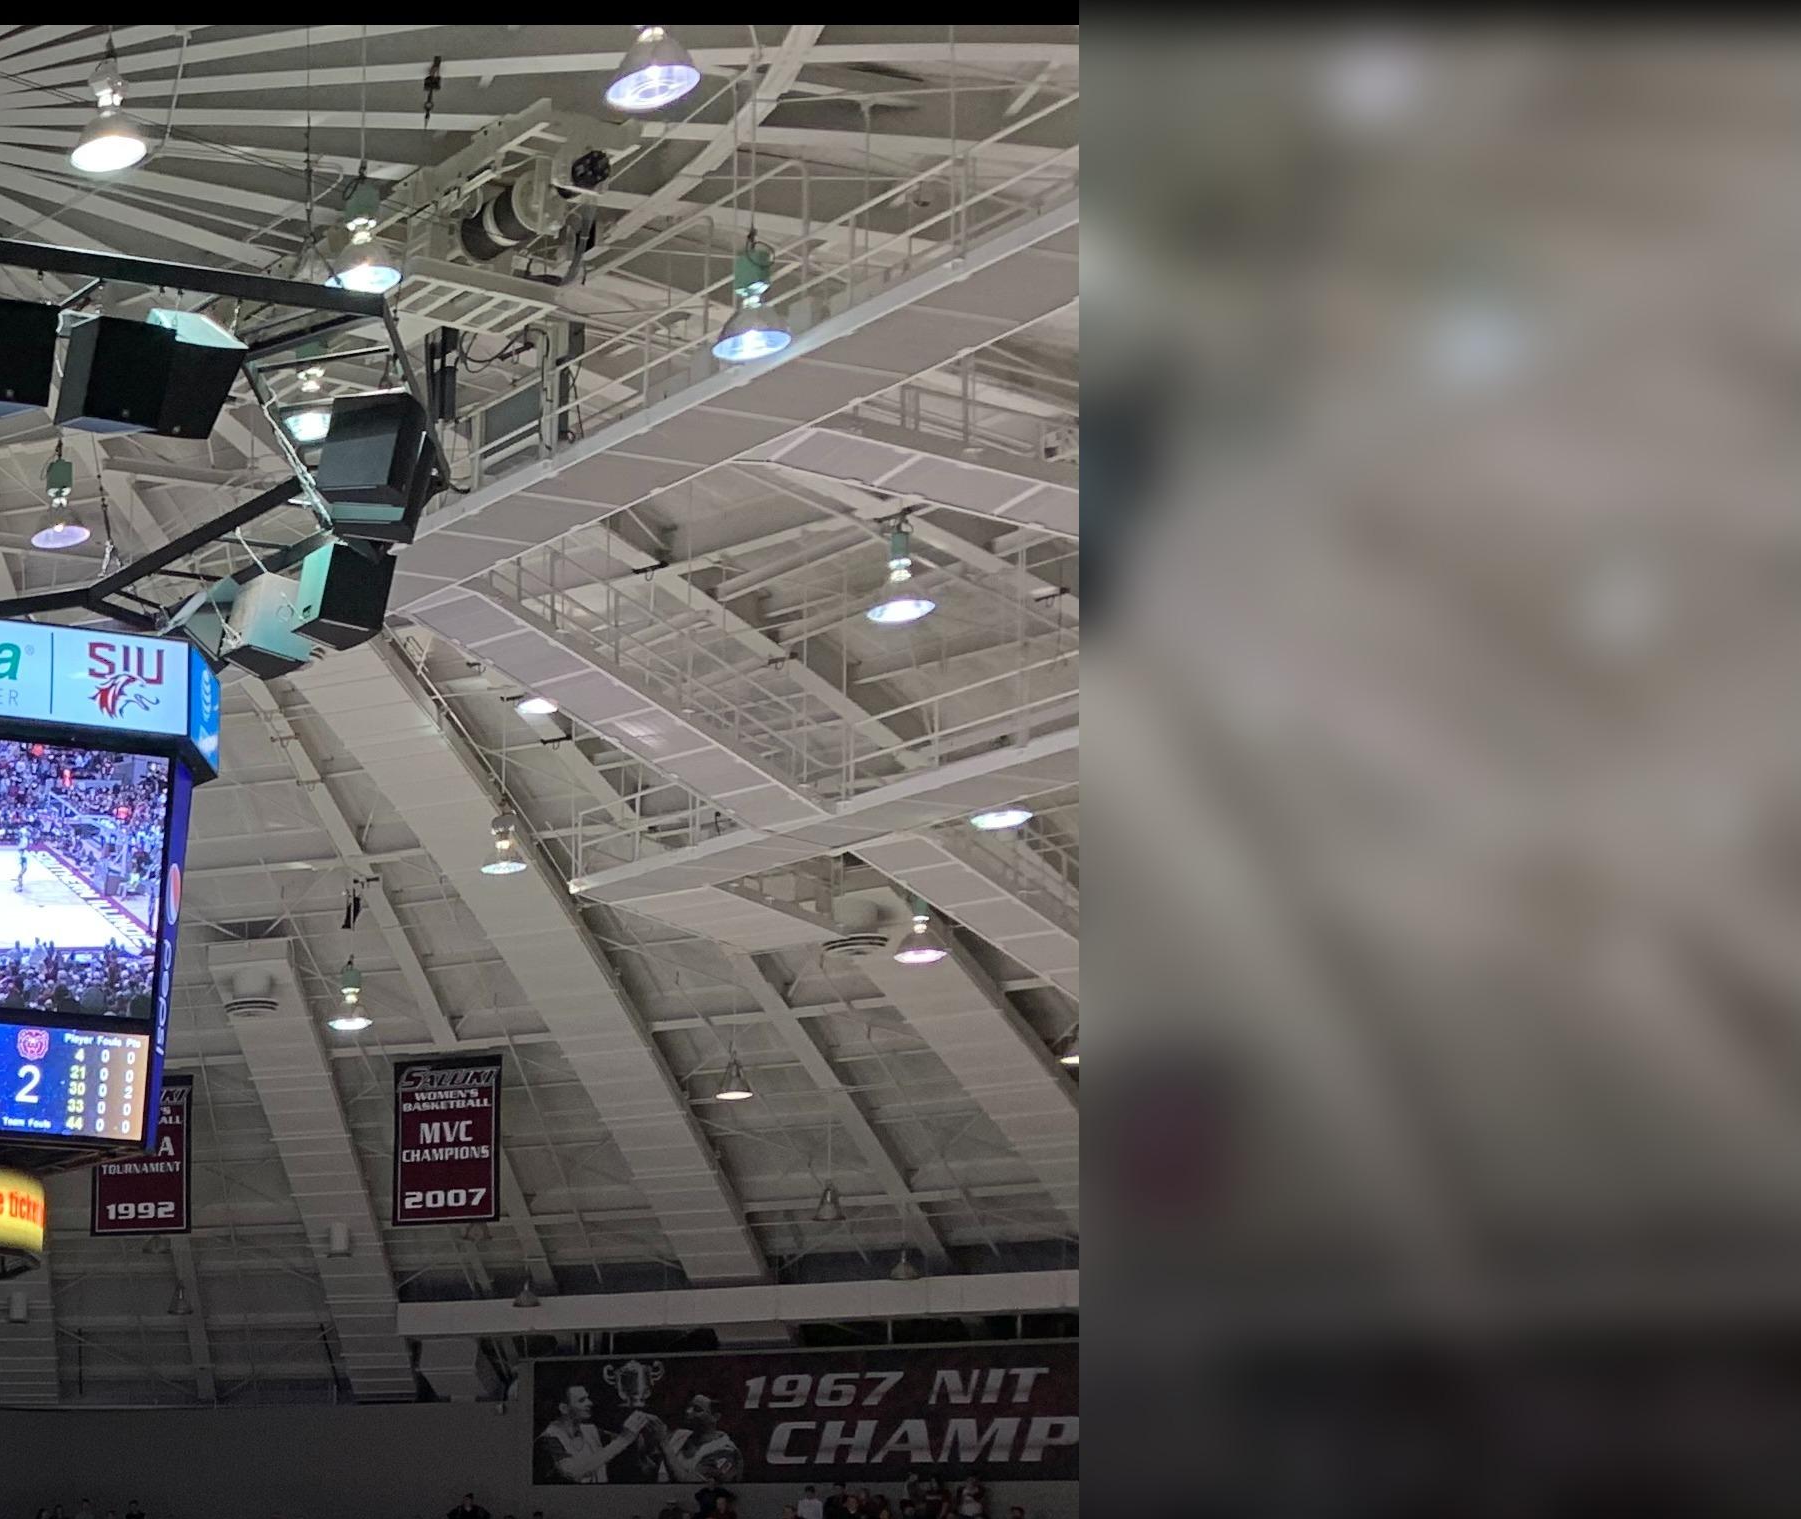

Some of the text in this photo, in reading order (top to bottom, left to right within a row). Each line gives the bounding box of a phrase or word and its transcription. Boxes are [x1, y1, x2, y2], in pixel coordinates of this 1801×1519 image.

[88, 642, 165, 685] SIU
[69, 1065, 86, 1079] 21
[15, 1064, 41, 1103] 2
[68, 1082, 85, 1095] 30
[67, 1099, 84, 1113] 33
[403, 1099, 491, 1112] BASKETBALL
[65, 1116, 84, 1130] 44
[419, 1120, 473, 1144] MVC
[402, 1145, 489, 1163] CHAMPIONS
[102, 1161, 181, 1175] TOURNAMENT
[405, 1188, 486, 1209] 2007
[106, 1202, 175, 1220] 1992
[744, 1367, 1050, 1409] 1967 NIT
[766, 1416, 1079, 1465] CHAMP
